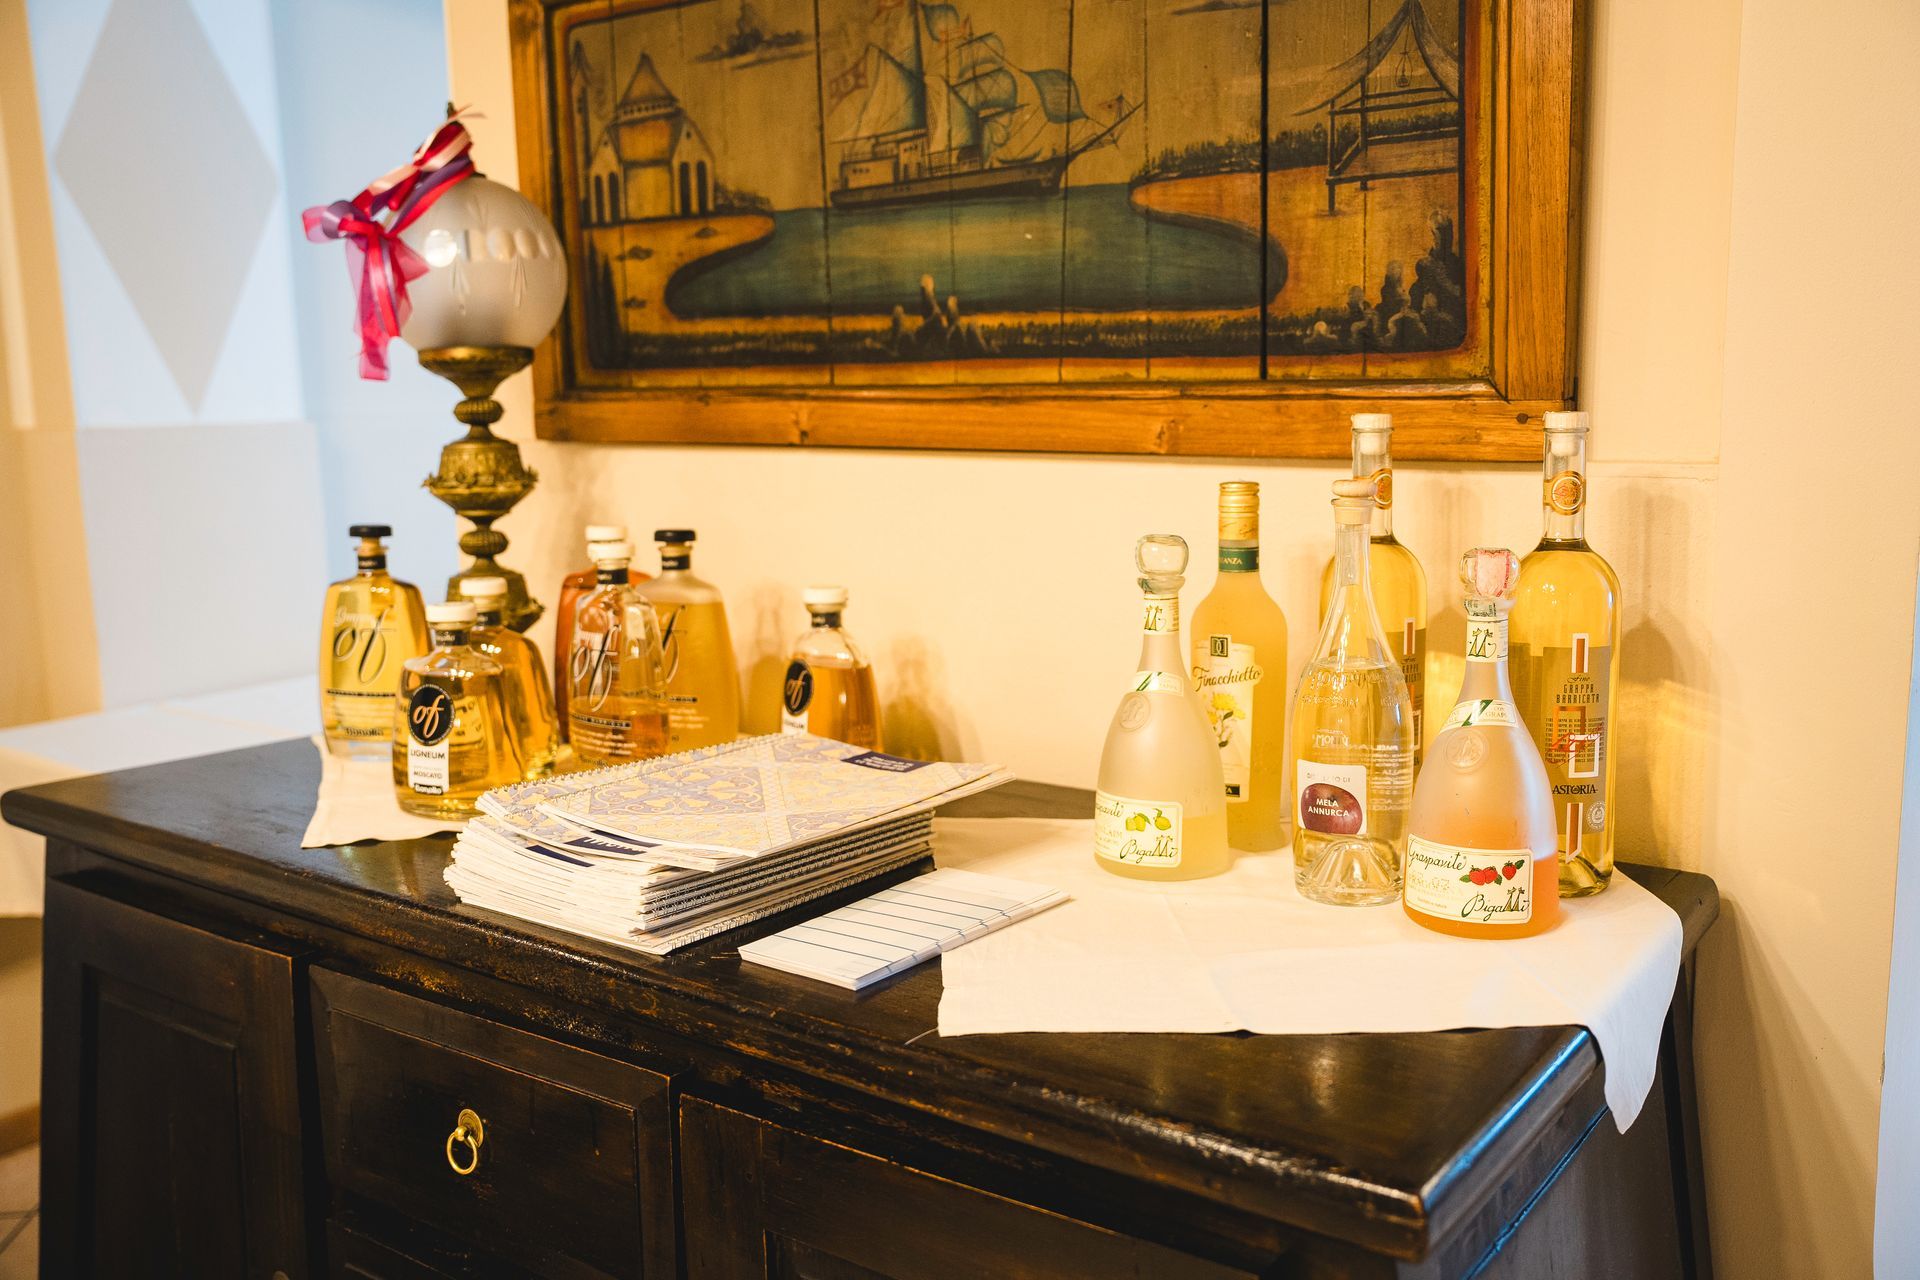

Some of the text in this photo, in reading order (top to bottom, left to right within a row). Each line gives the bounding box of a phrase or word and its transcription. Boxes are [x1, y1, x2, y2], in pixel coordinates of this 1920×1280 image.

[1563, 683, 1594, 694] GRAPPA
[1555, 693, 1600, 704] BARRICATA
[412, 694, 445, 739] of
[410, 750, 446, 759] LIGNEUM
[1551, 783, 1599, 795] ASTORIA
[1316, 798, 1339, 807] MELA
[1307, 806, 1350, 817] ANNURCA
